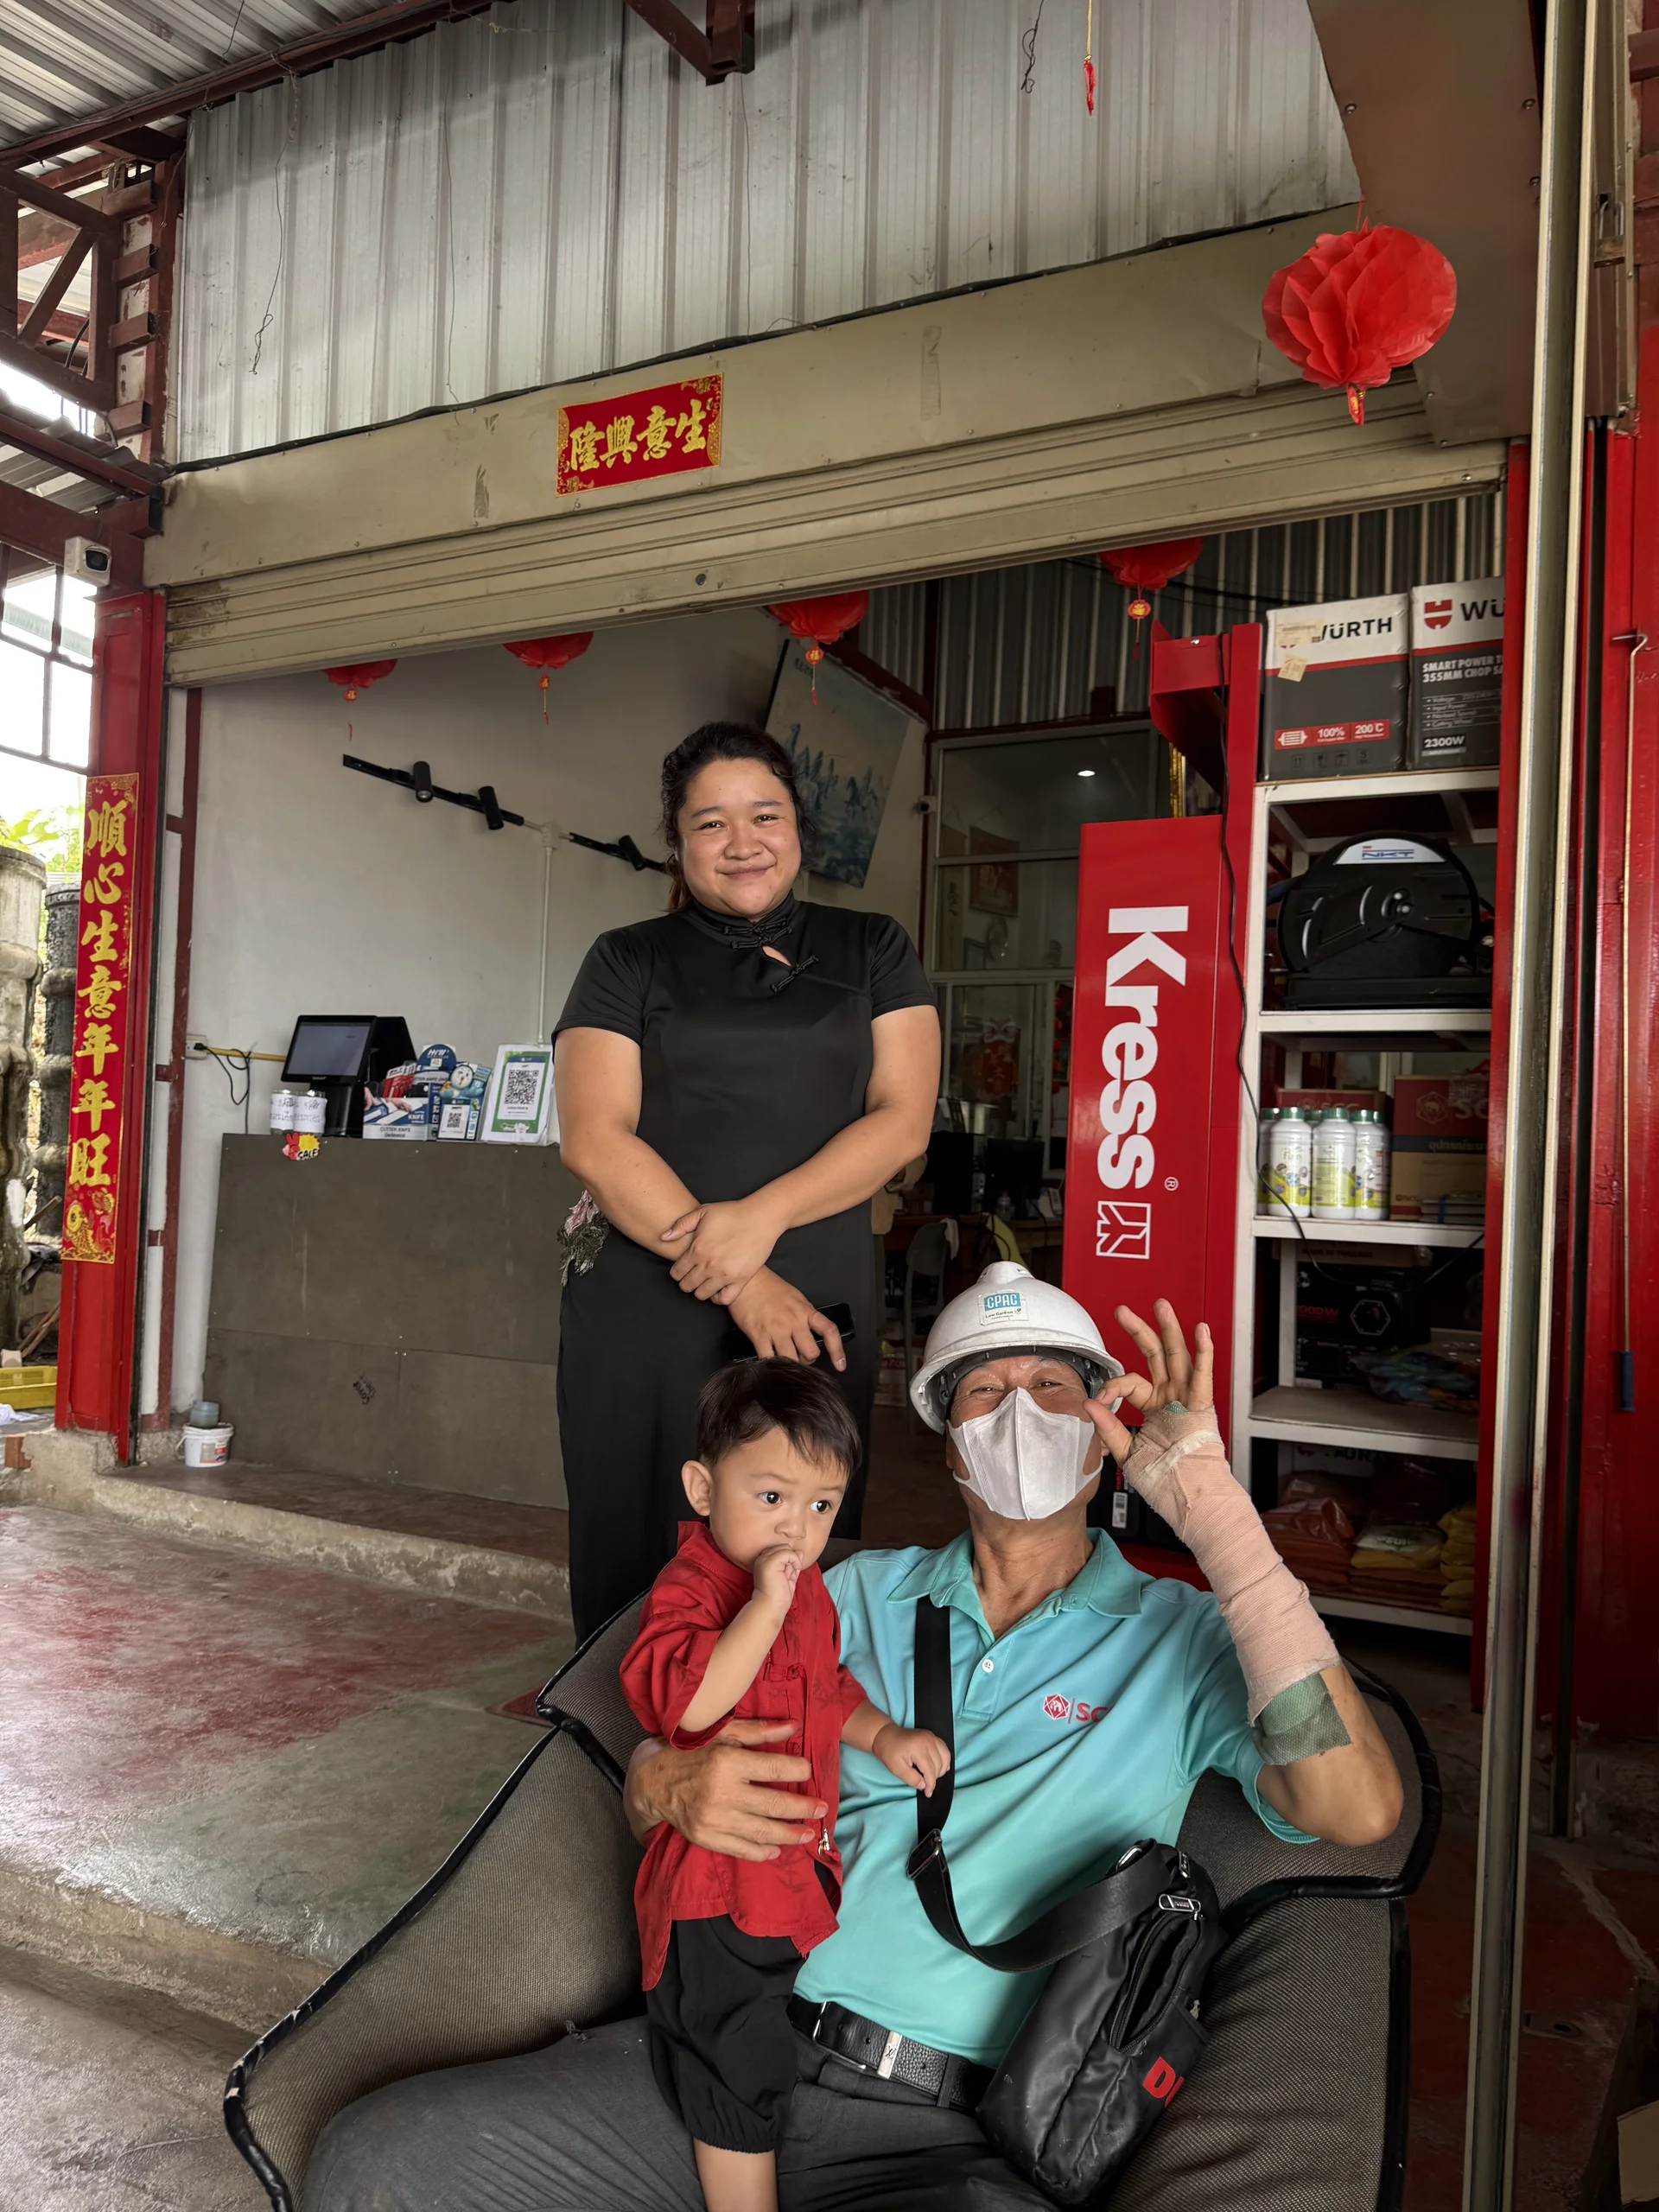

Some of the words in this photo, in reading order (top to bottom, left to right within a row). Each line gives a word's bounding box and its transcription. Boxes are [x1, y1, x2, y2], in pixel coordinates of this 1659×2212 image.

[1422, 659, 1457, 673] SMART
[1458, 655, 1494, 669] POWER
[1422, 670, 1463, 683] 355MM
[1464, 666, 1492, 678] CHOP
[1318, 727, 1345, 738] 100%
[1424, 735, 1465, 748] 2300W
[1097, 906, 1189, 1190] Kress
[987, 1294, 1018, 1308] CPAC
